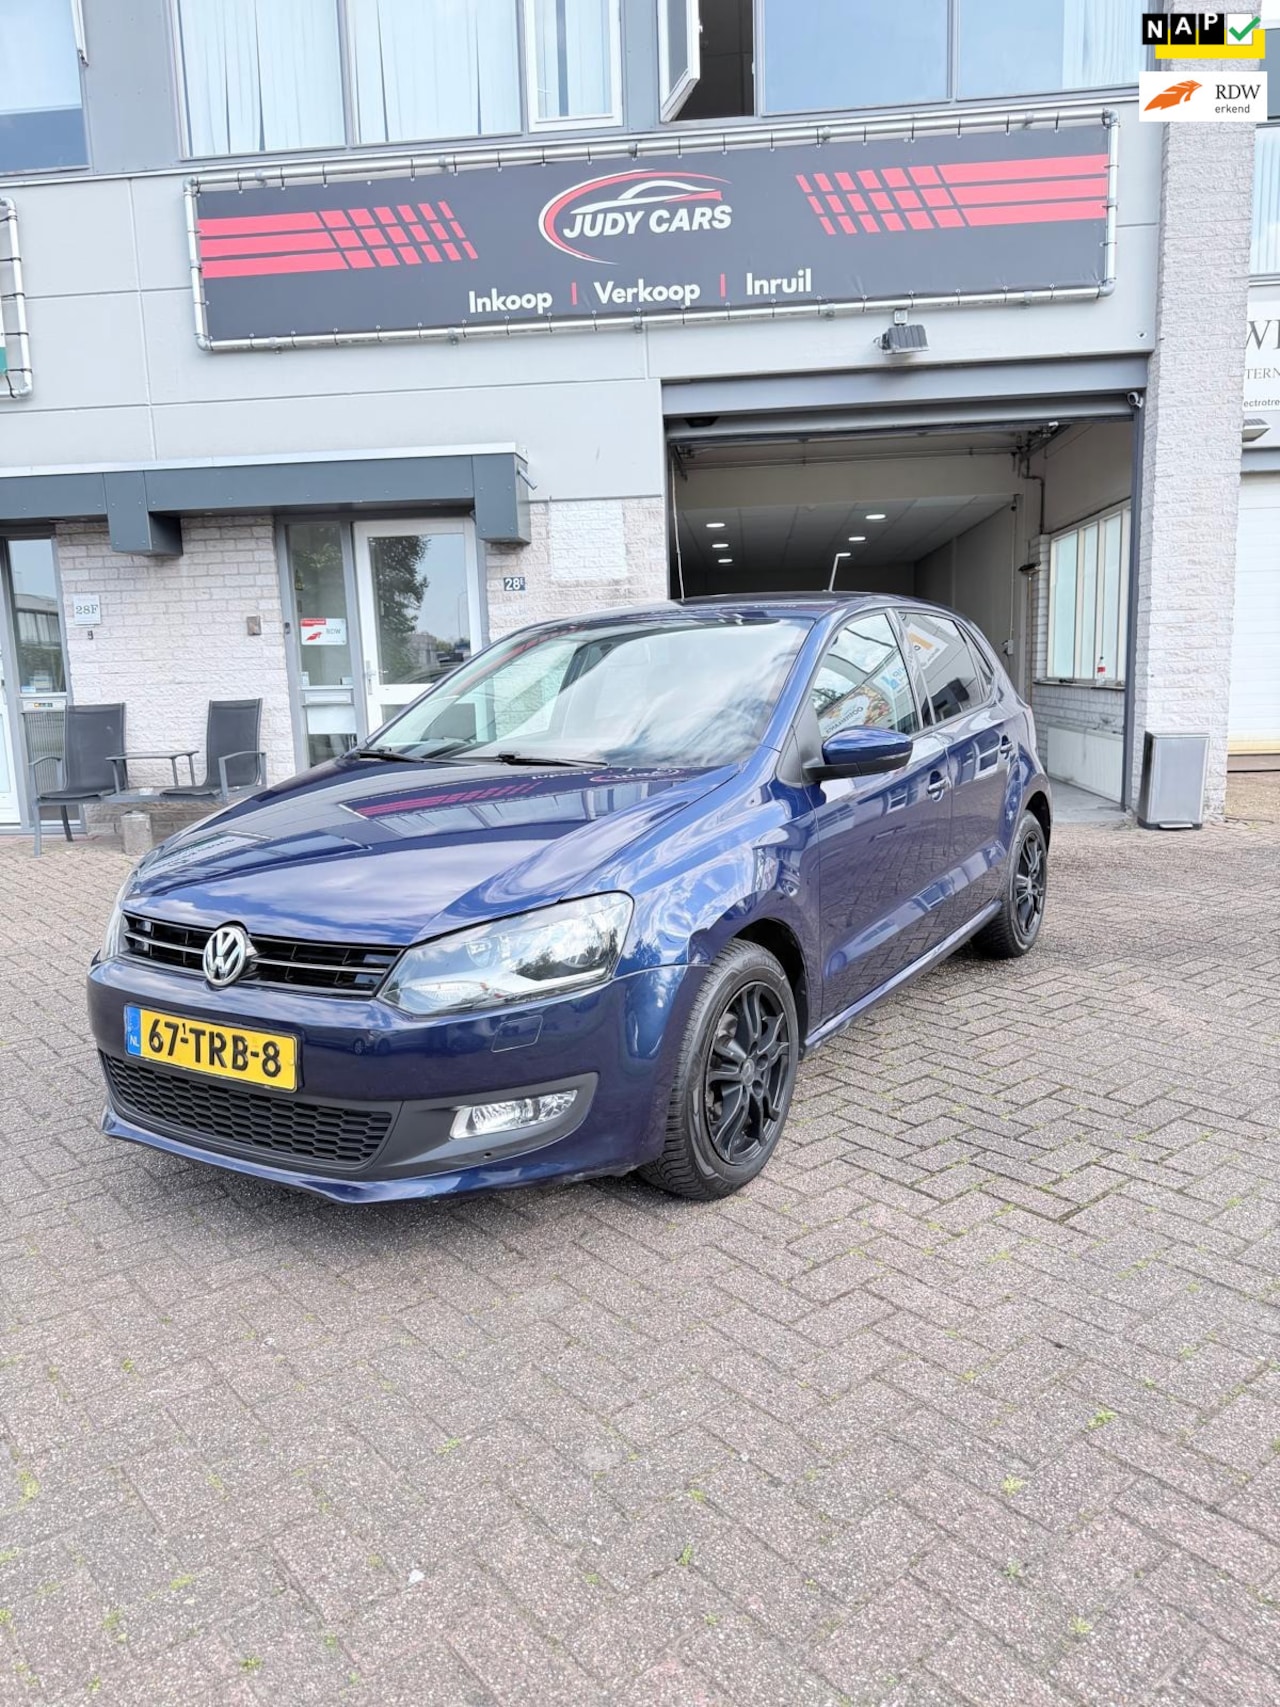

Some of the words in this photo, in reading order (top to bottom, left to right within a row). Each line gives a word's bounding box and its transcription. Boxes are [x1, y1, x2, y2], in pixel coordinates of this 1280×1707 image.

[563, 211, 645, 239] JUDY
[649, 205, 732, 234] CARS
[468, 288, 553, 314] Inkoop
[593, 278, 701, 306] Verkoop
[746, 268, 812, 296] Inruil
[75, 604, 99, 615] 28F
[129, 1034, 140, 1047] NL
[148, 1018, 282, 1078] 67-TRB-8
